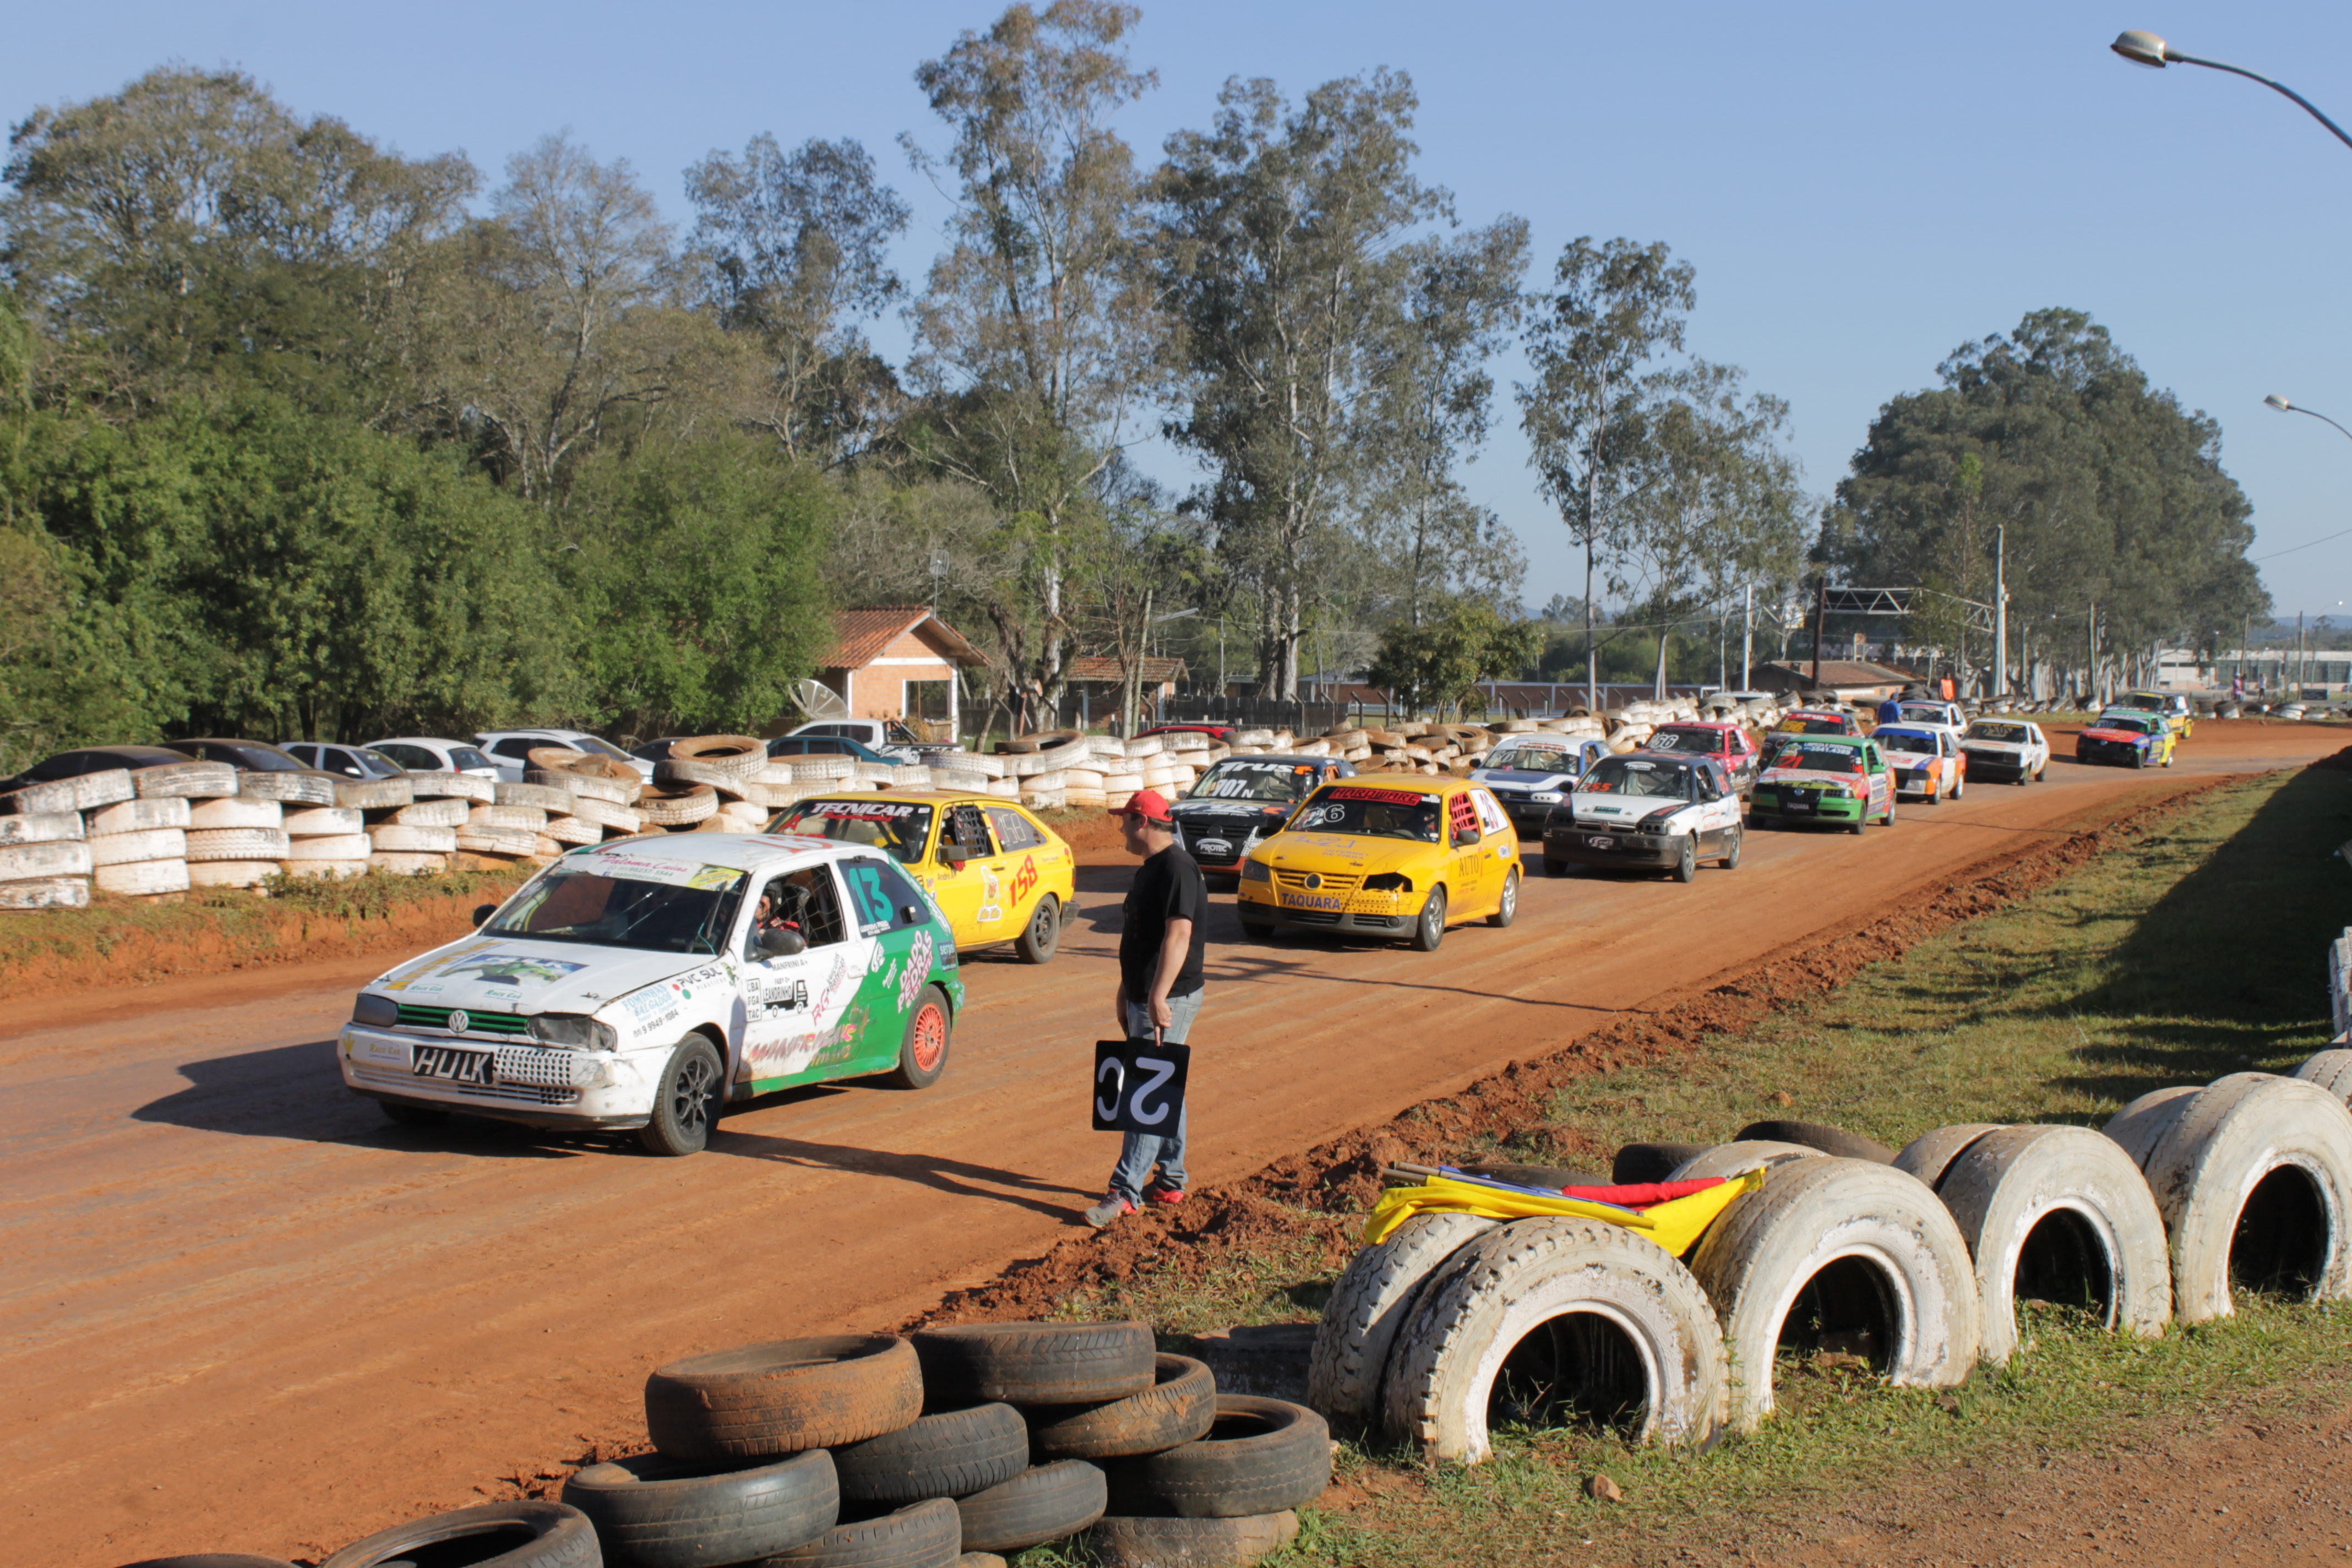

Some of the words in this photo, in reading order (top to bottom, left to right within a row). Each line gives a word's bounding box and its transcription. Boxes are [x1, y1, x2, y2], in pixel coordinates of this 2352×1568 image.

[1777, 755, 1804, 769] 21
[1211, 779, 1248, 797] 707
[1242, 790, 1254, 798] N
[1579, 782, 1613, 792] 255
[810, 803, 914, 817] TECNICAR
[998, 813, 1027, 844] 158
[1200, 843, 1227, 853] PROTEC
[1325, 848, 1370, 857] INTERNET
[599, 856, 652, 867] Paloma
[1458, 855, 1479, 876] AUTO
[1009, 854, 1038, 909] 158
[849, 867, 894, 924] 13
[1282, 892, 1341, 911] TAQUARA
[772, 960, 800, 971] MANFRINI
[900, 929, 923, 992] DADO
[676, 973, 701, 987] PVC
[699, 967, 722, 979] SUL
[897, 929, 933, 1014] PEDRAS
[747, 982, 759, 992] CBA
[763, 985, 792, 1002] LEANDRINHO
[621, 984, 668, 1011] FOMINHAS
[634, 991, 672, 1017] SALGADOS
[643, 1026, 647, 1035] 9
[647, 1008, 679, 1031] 9949-1084
[748, 1009, 760, 1019] TAC
[413, 1048, 491, 1085] HULK
